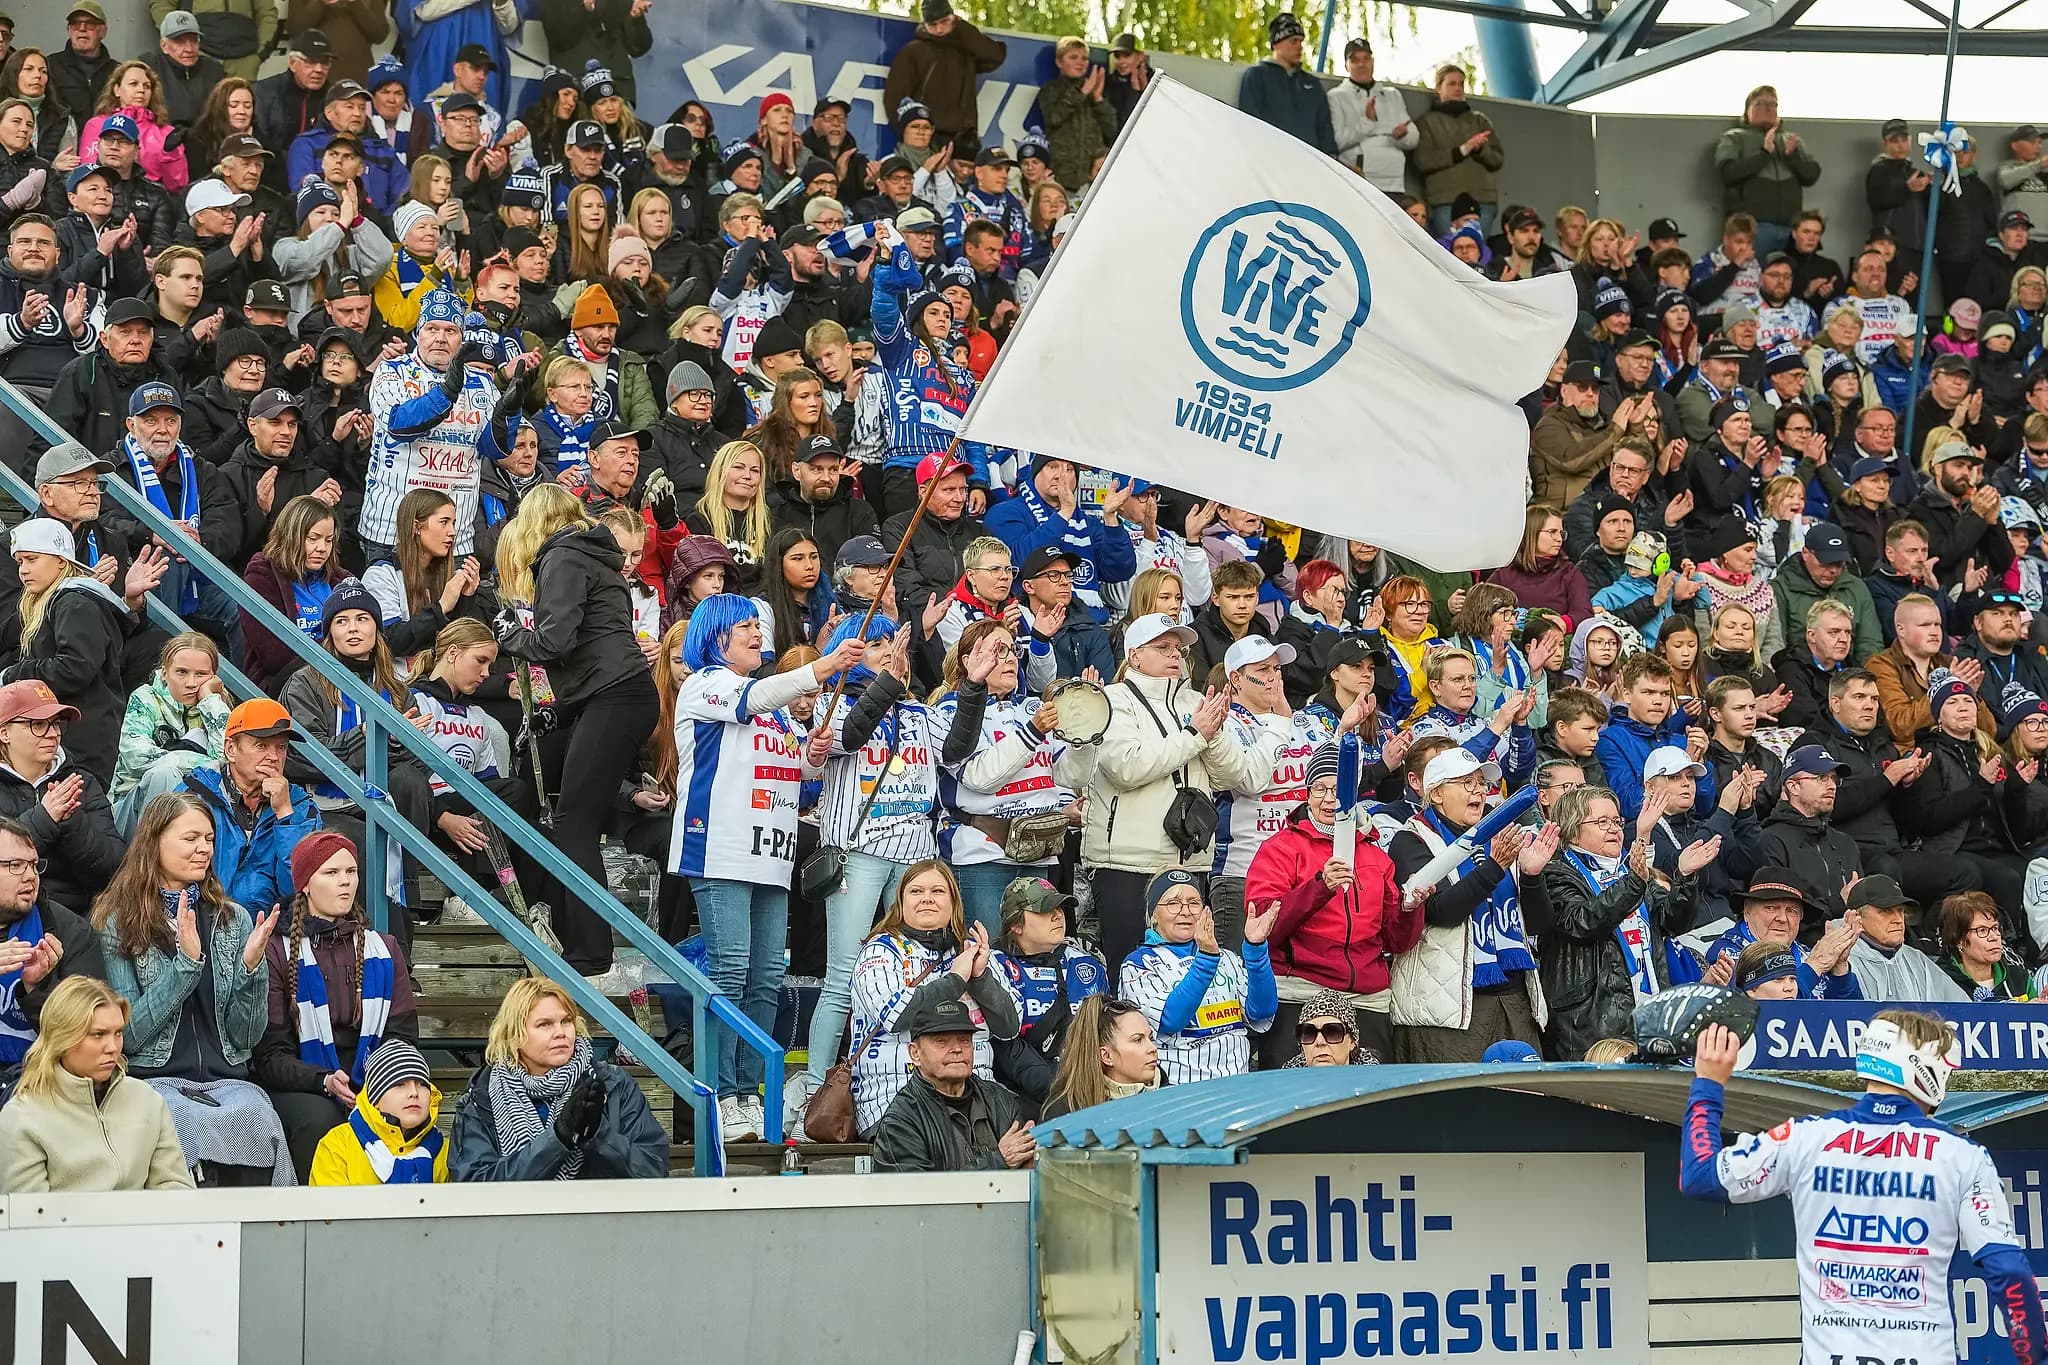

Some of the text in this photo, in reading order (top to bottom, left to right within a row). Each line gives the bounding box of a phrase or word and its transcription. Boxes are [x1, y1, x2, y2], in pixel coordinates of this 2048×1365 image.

[736, 317, 766, 329] Bets
[1195, 380, 1273, 425] 1934
[1174, 397, 1283, 461] VIMPELI
[1872, 1102, 1898, 1116] 2026
[1822, 1127, 1940, 1162] AVANT
[1811, 1164, 1937, 1202] HEIKKALA
[1209, 1175, 1454, 1266] Rahti-
[1813, 1205, 1930, 1246] ATENO
[1818, 1260, 1920, 1284] NELIMARKAN
[1849, 1282, 1921, 1301] LEIPOMO
[1204, 1262, 1613, 1365] vapaasti.fi
